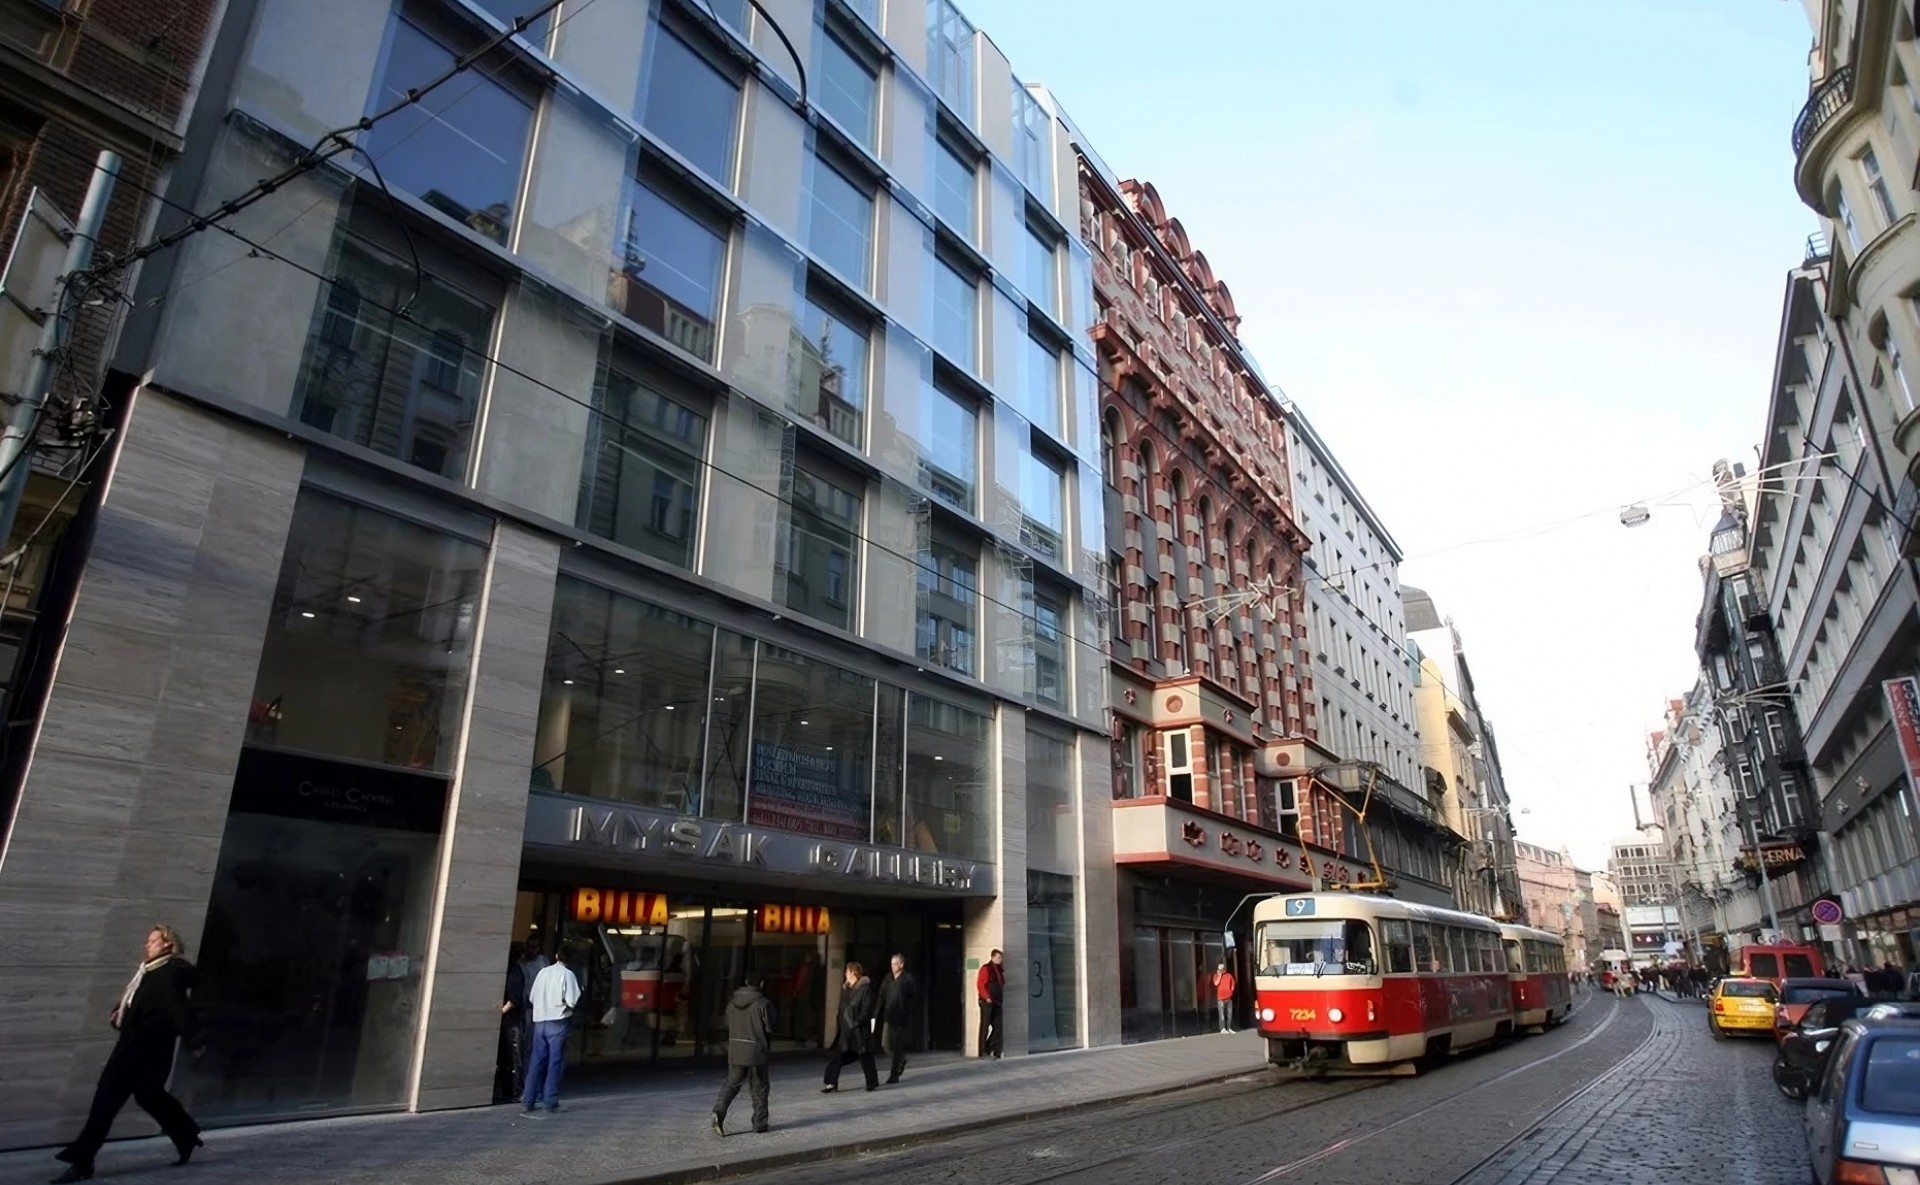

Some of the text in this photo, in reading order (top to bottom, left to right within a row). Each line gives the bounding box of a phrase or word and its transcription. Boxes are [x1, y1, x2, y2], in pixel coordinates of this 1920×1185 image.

[577, 887, 668, 925] BILLA
[1294, 899, 1306, 914] 9
[764, 903, 832, 933] BILLA
[1289, 1008, 1316, 1021] 7234
